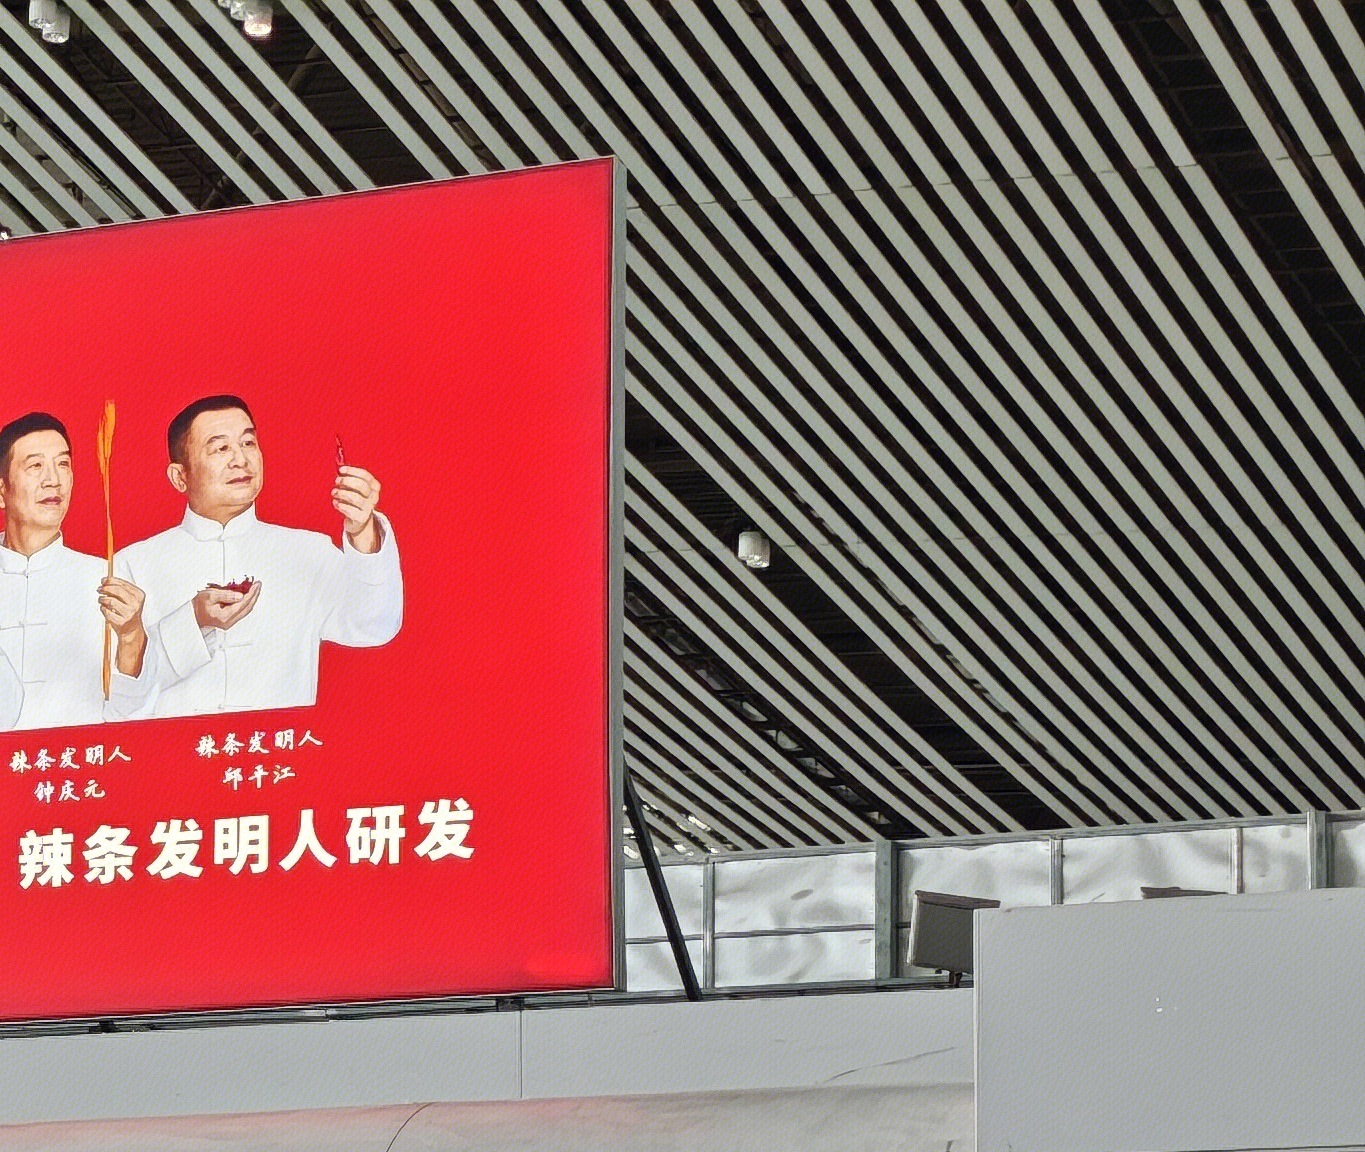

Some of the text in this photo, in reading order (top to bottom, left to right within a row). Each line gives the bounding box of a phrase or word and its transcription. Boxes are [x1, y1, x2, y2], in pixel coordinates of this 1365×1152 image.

[194, 728, 324, 758] 辣条发明人
[8, 743, 132, 774] 辣条发明人
[34, 777, 106, 803] 钟庆元
[222, 764, 296, 792] 邱平江
